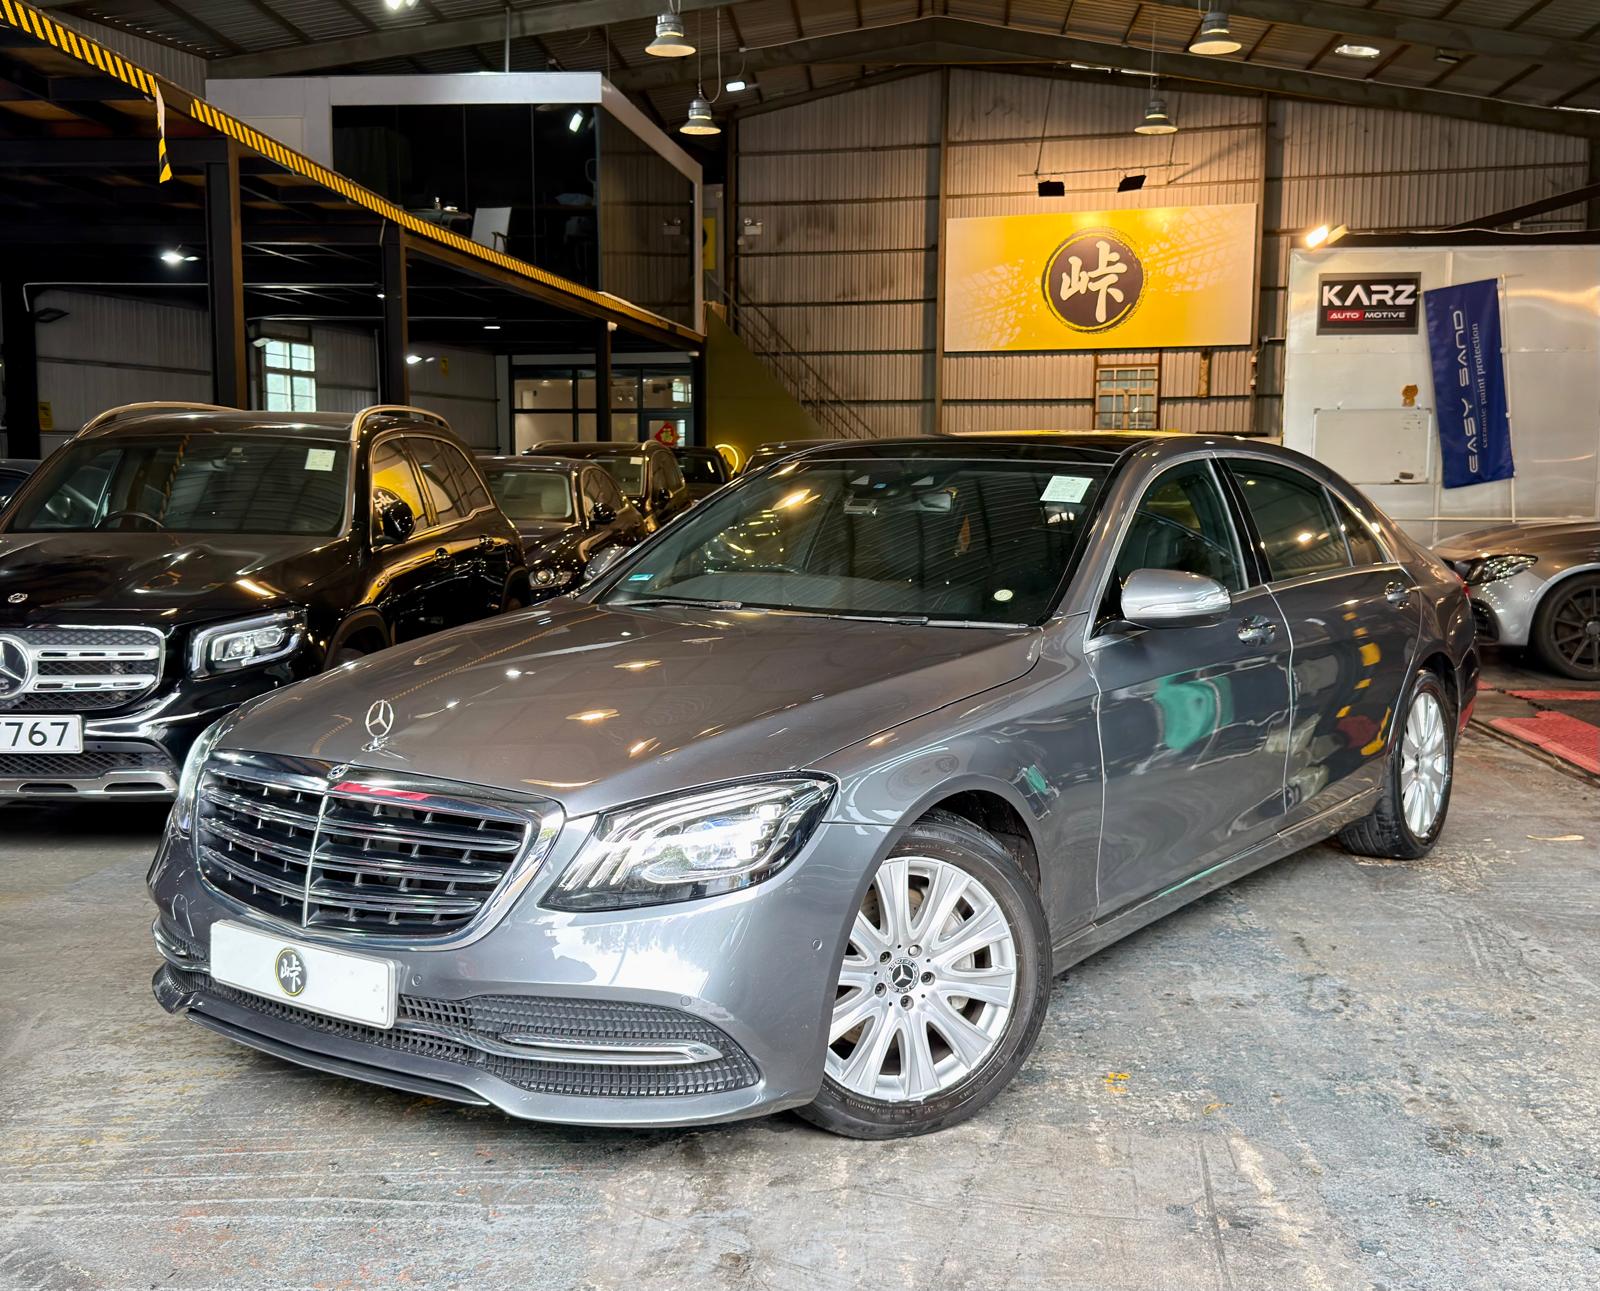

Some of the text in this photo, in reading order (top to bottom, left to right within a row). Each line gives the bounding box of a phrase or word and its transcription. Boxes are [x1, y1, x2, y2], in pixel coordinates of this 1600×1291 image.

[1060, 240, 1127, 322] 峠
[1322, 284, 1416, 306] KARZ
[1330, 311, 1406, 319] AUTO MOTIVE
[1471, 323, 1486, 375] protection
[1453, 310, 1478, 473] EASY SAND
[1477, 379, 1487, 405] paint
[0, 722, 69, 746] 767
